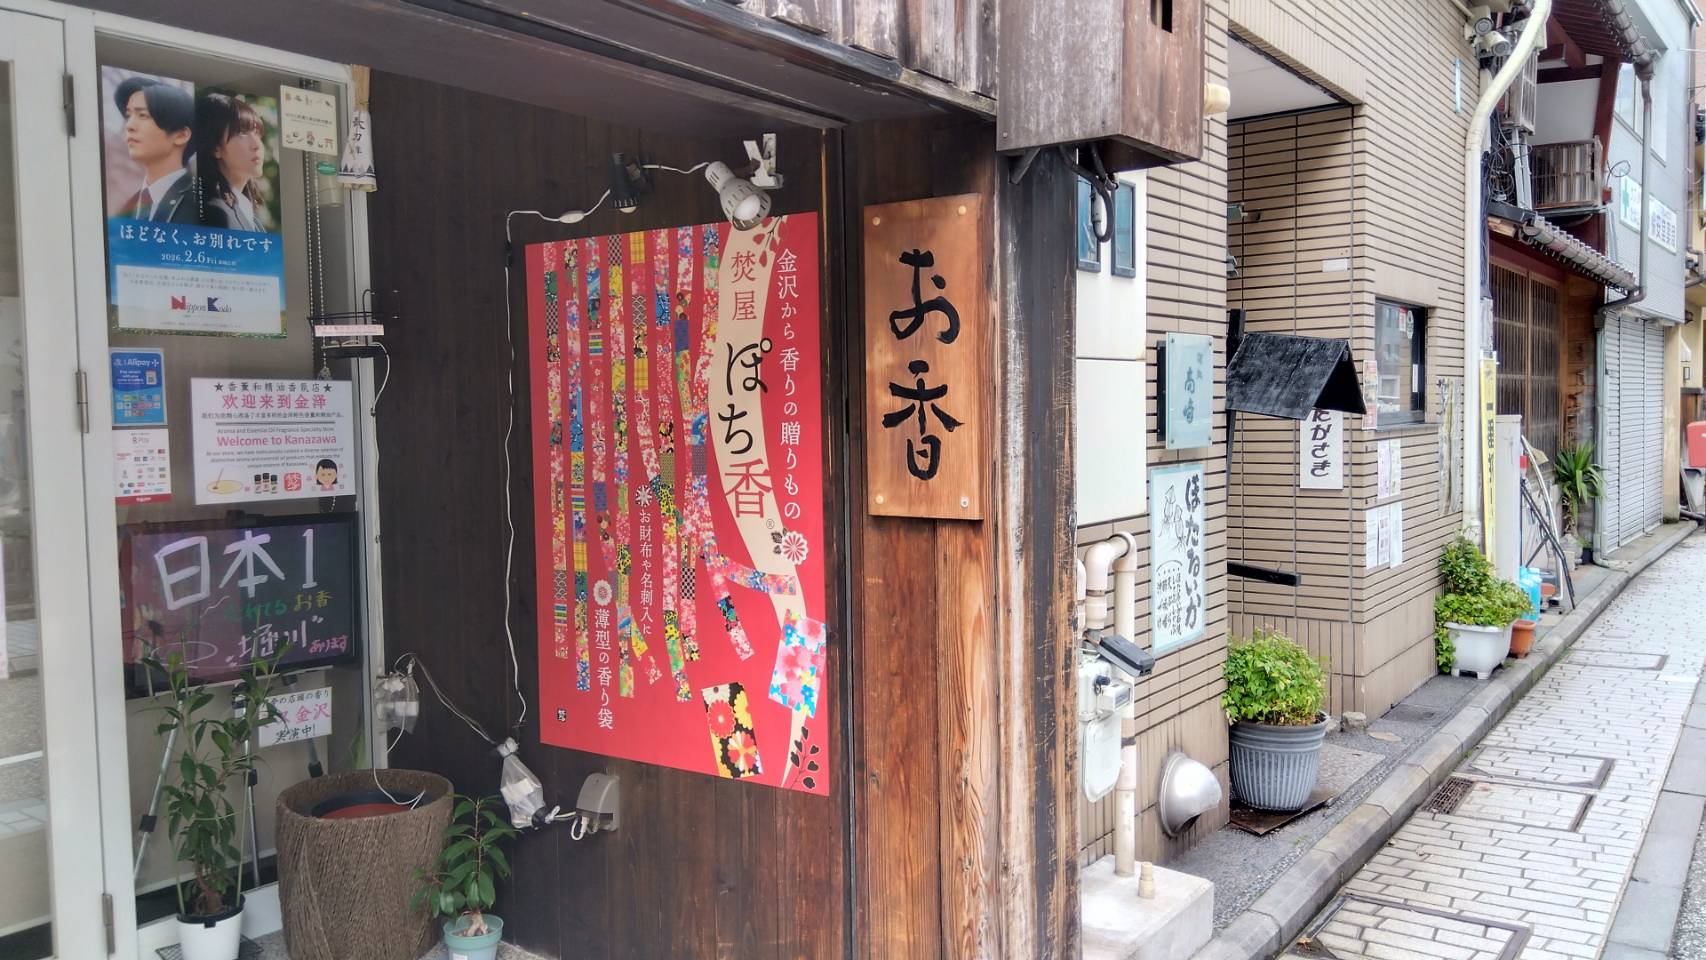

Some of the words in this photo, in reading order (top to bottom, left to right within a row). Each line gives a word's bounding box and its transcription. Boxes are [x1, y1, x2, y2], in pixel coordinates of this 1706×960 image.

[120, 225, 273, 253] ほどなく、お別れです
[222, 394, 327, 410] 欢迎来到金泽
[776, 248, 801, 520] 金沢から香りの贈りもの
[881, 248, 965, 481] お香
[216, 436, 269, 447] Welcome
[271, 436, 282, 445] to
[285, 435, 337, 445] Kanazawa
[718, 337, 773, 519] ぽち香
[638, 508, 654, 635] お財布や名刺入に
[1185, 474, 1201, 630] ほたるいか
[308, 635, 349, 654] あります
[594, 608, 613, 730] 薄型の香り袋
